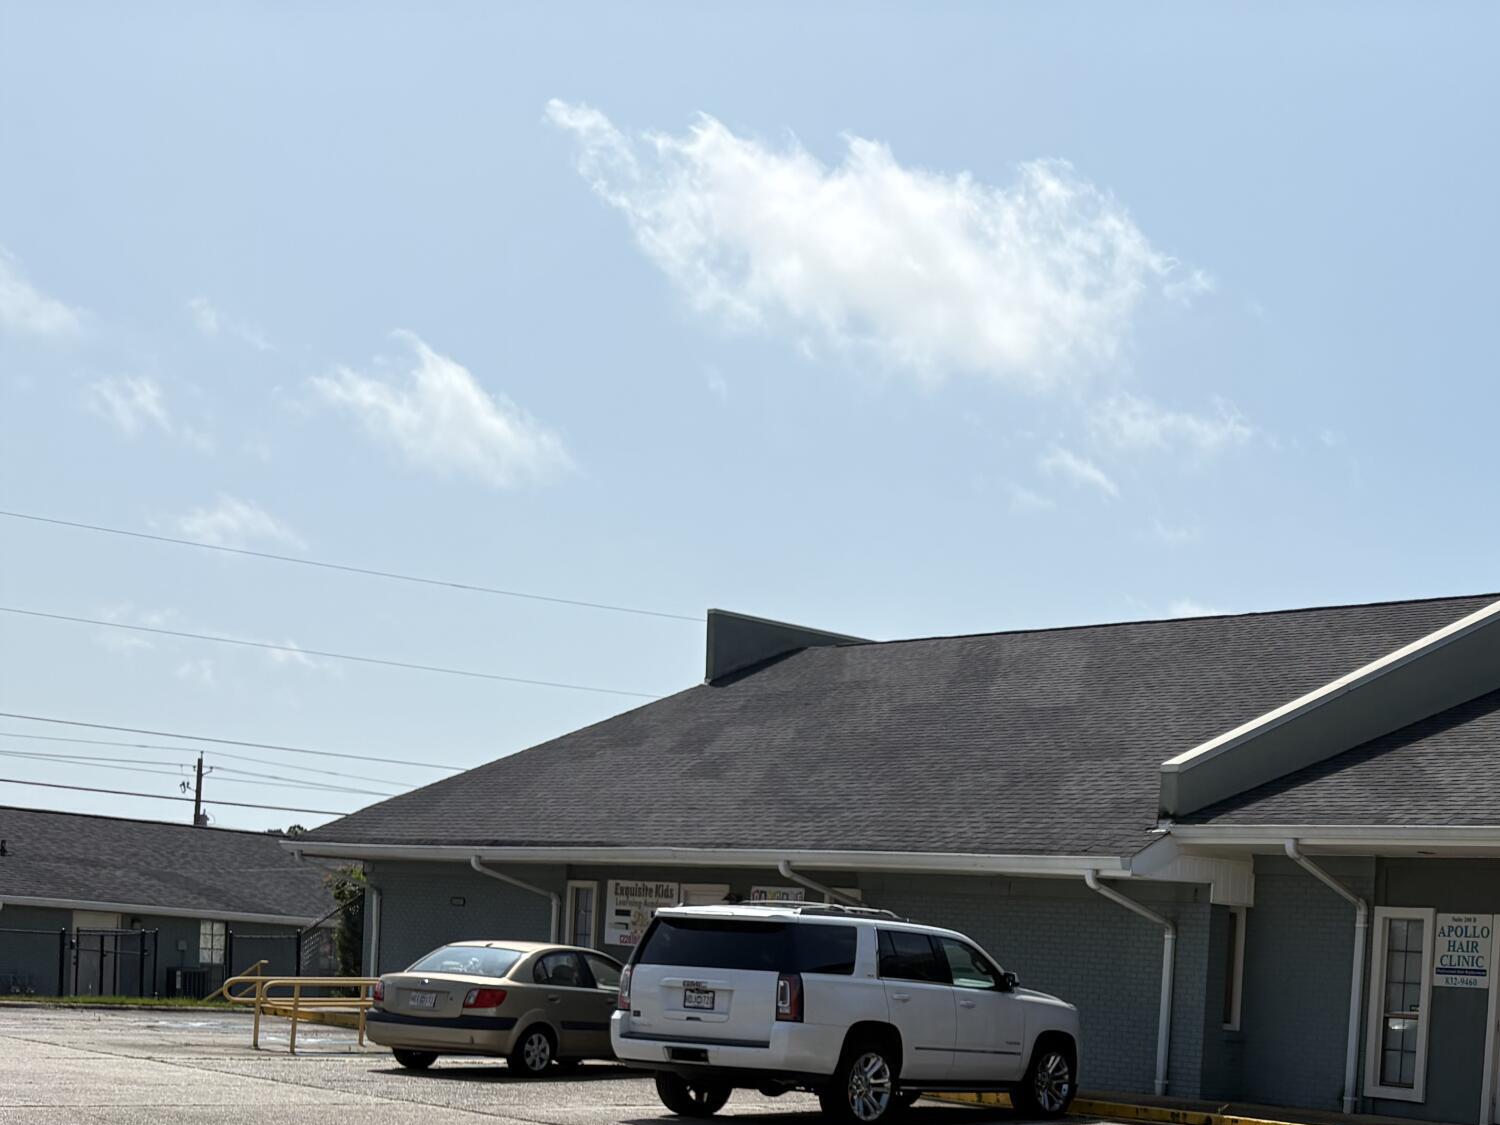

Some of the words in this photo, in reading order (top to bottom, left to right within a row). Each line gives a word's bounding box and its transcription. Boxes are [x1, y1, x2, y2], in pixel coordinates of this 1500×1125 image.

[615, 883, 654, 899] Exquisite
[655, 884, 674, 898] Kids
[1438, 925, 1490, 938] APOLLO
[1447, 940, 1480, 953] HAIR
[1440, 954, 1485, 968] CLINIC
[1445, 977, 1478, 986] 832-9460
